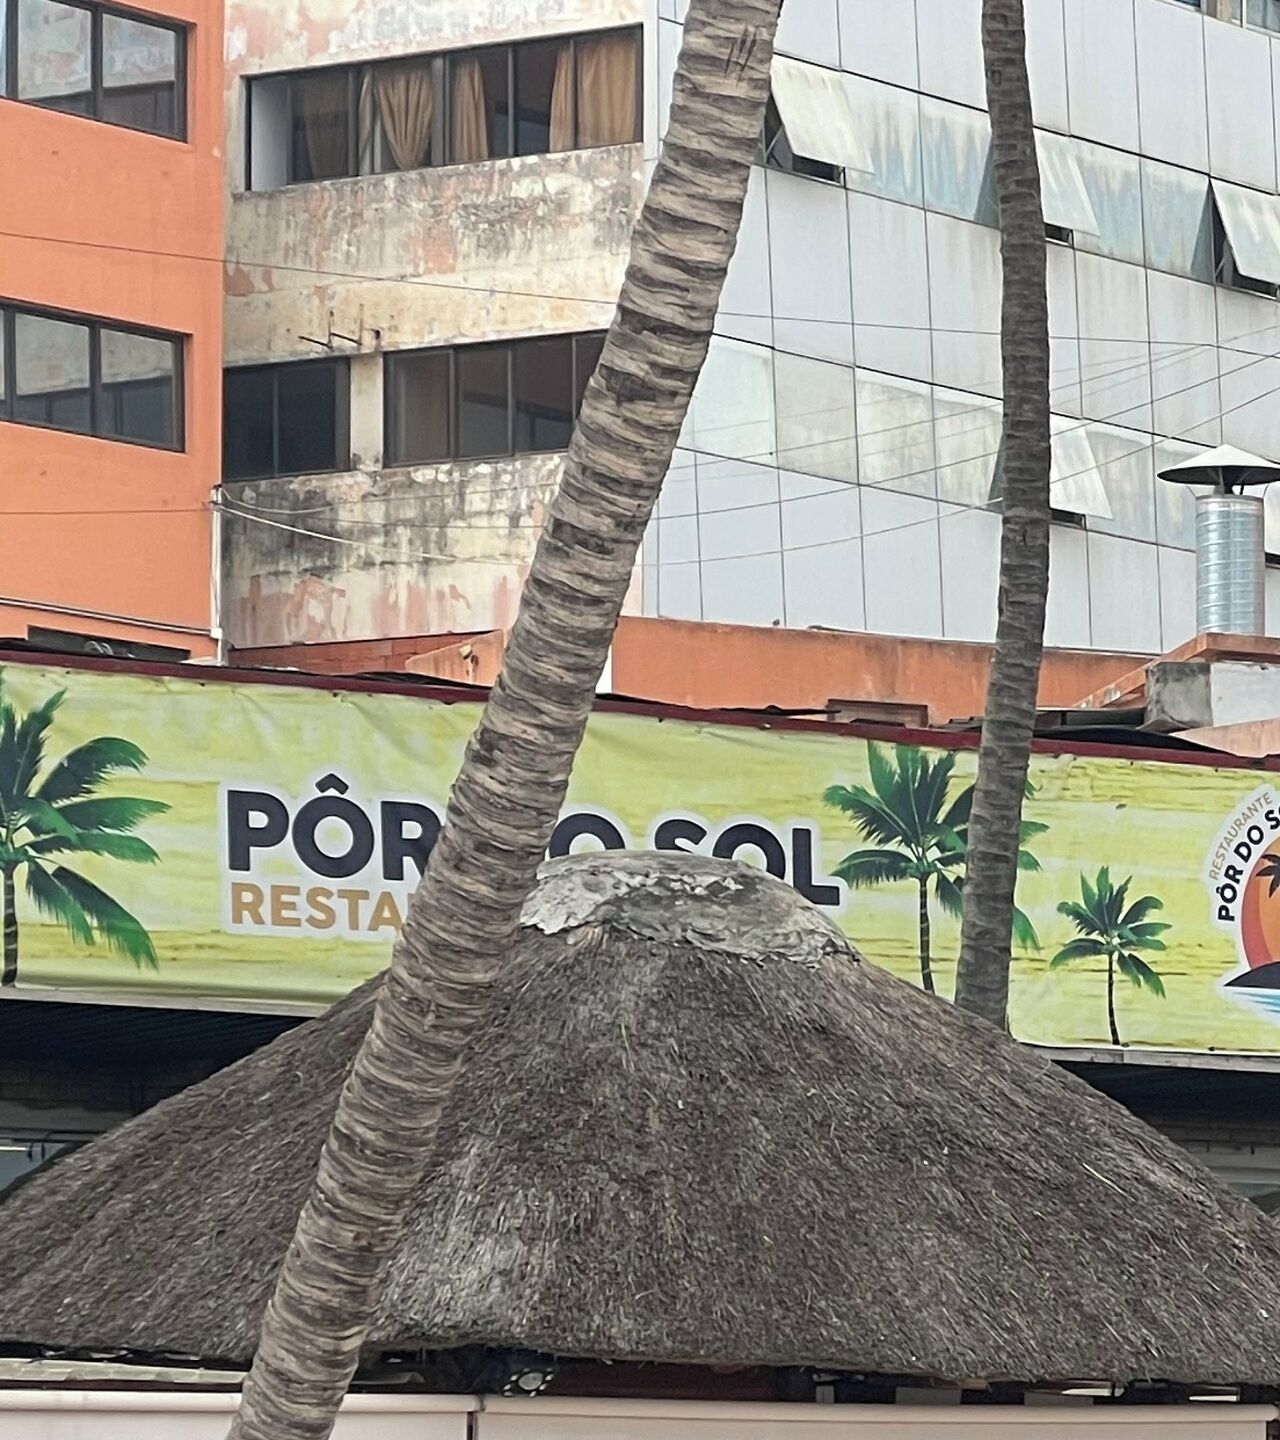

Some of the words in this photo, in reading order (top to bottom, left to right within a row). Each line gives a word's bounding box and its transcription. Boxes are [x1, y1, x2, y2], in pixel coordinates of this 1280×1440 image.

[227, 772, 442, 881] PÔR
[1208, 792, 1274, 881] RESTAURANTE
[231, 881, 414, 933] RESTA
[1215, 864, 1244, 922] PÔR
[1233, 825, 1264, 863] DO
